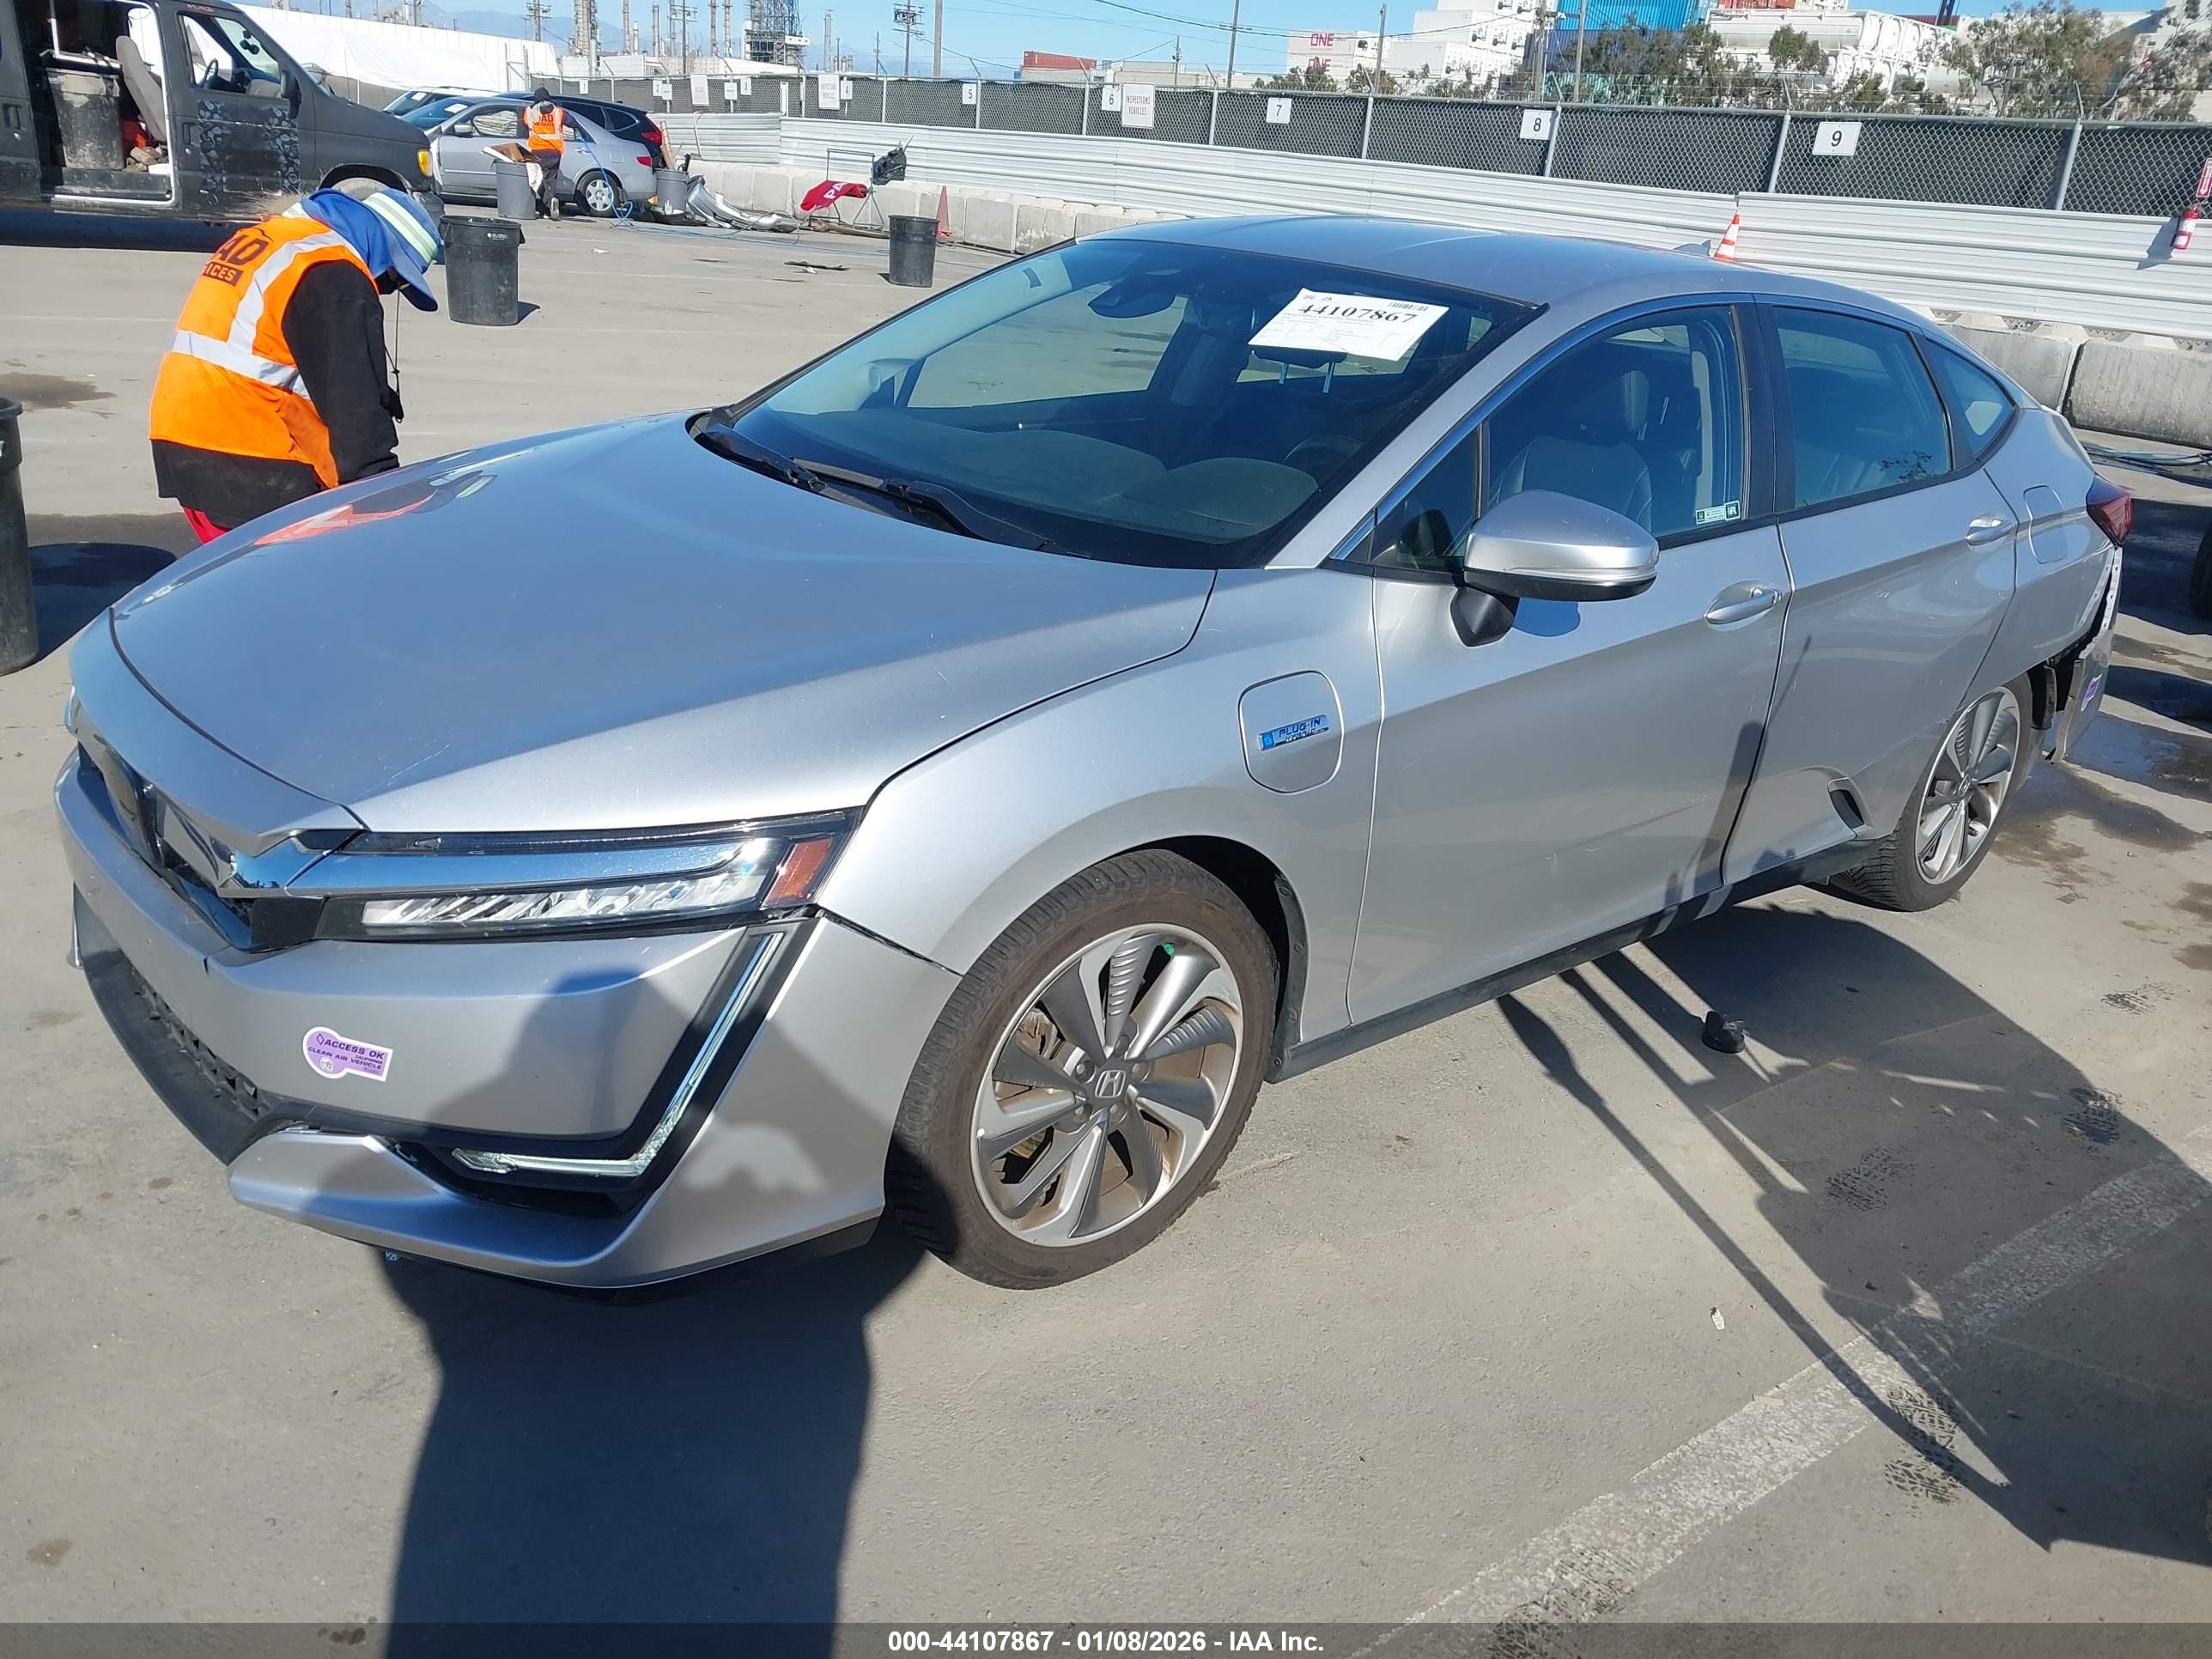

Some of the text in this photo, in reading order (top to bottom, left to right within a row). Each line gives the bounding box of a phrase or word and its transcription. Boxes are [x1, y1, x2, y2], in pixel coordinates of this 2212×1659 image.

[1310, 33, 1334, 46] ONE
[968, 89, 973, 100] 5
[1109, 94, 1115, 106] 6
[1126, 95, 1151, 105] INSPECTIONS
[1128, 106, 1147, 115] VEHICLES
[1276, 104, 1282, 117] 7
[1533, 117, 1542, 132] 8
[1831, 130, 1842, 147] 9
[1297, 304, 1419, 323] 44107867
[1279, 718, 1322, 738] PLUG-IN
[324, 1039, 385, 1060] ACCESS OK
[307, 1046, 333, 1057] CLEAN
[350, 1058, 382, 1070] VEHICLE
[355, 1054, 383, 1065] CALIFORNIA
